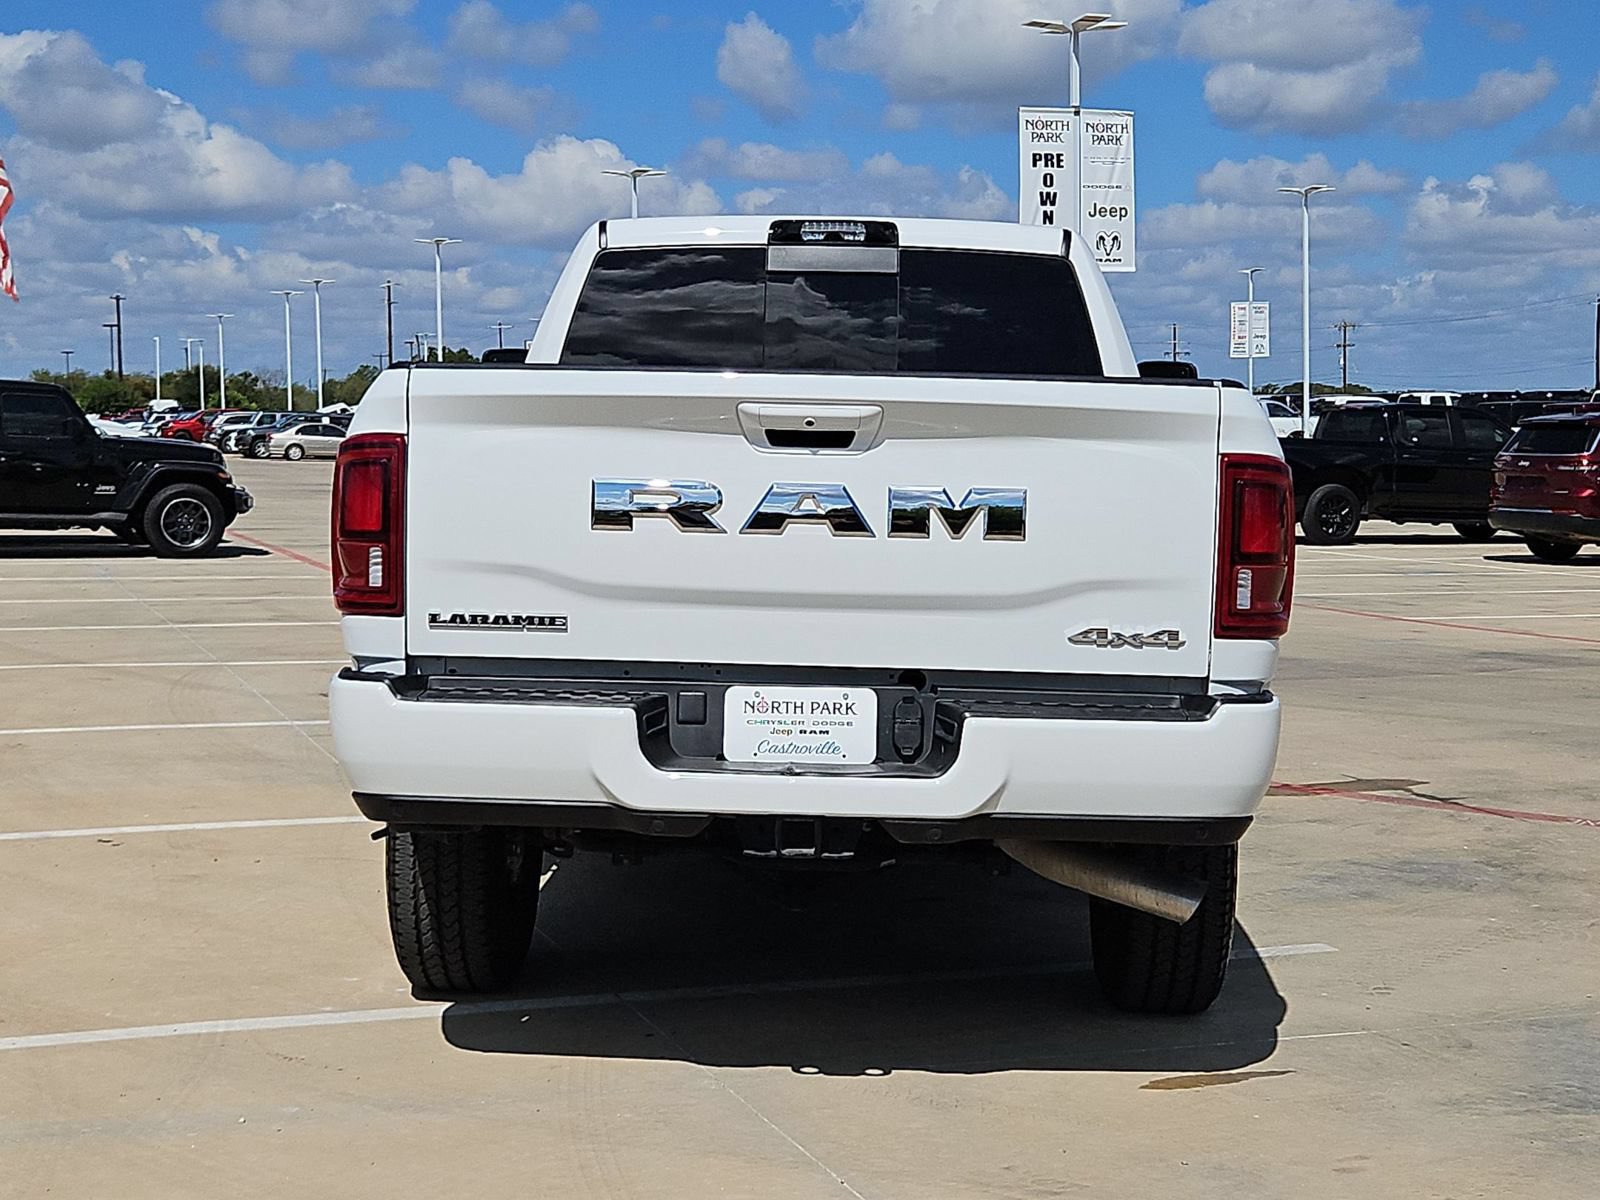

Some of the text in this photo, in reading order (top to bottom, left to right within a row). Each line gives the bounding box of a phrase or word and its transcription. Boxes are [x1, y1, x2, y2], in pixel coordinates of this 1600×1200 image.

[1025, 117, 1070, 132] NORTH
[1085, 120, 1129, 134] NORTH
[1031, 132, 1064, 143] PARK
[1091, 135, 1123, 146] PARK
[1032, 152, 1064, 168] PRE
[1088, 202, 1128, 221] Jeep
[591, 478, 1028, 542] RAM
[428, 612, 569, 632] LARAMIE
[743, 697, 858, 716] NORTH PARK
[769, 727, 793, 736] Jeep
[757, 739, 842, 756] Castroville
